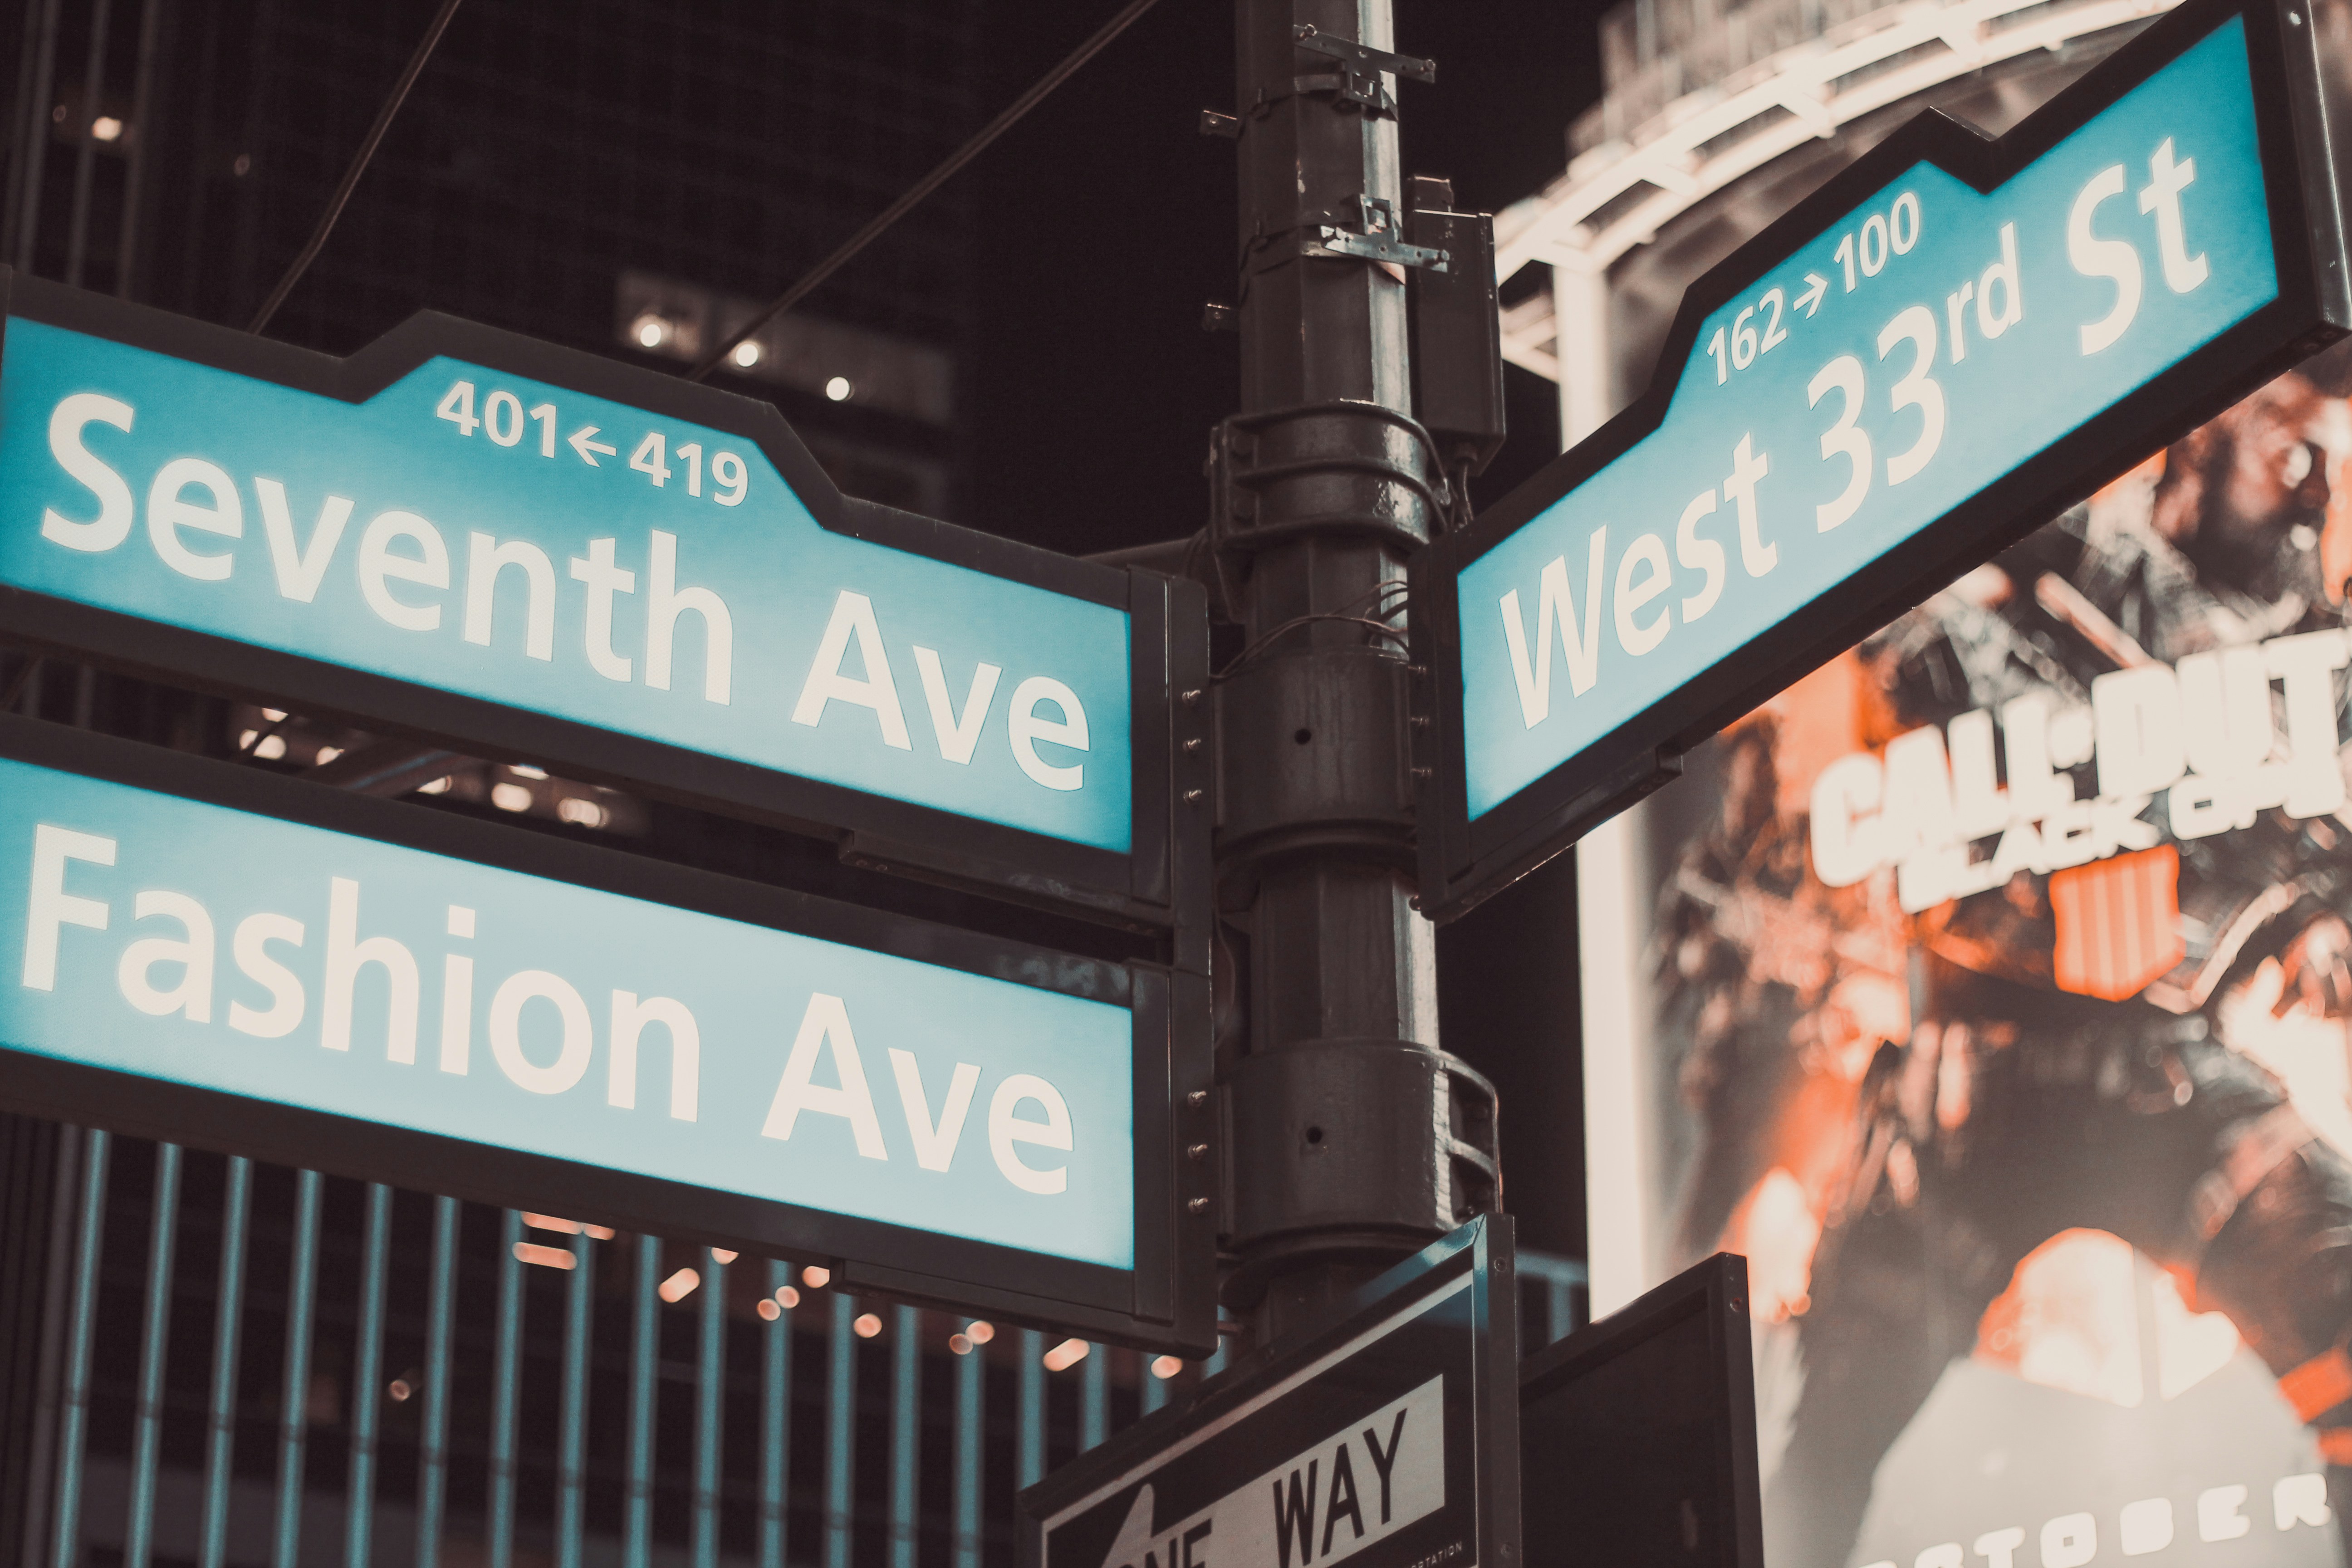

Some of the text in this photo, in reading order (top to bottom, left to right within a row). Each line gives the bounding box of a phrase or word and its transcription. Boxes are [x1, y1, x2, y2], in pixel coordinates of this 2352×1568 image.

[1706, 191, 1920, 387] 162 100
[436, 380, 749, 507] 401 419
[1498, 136, 2210, 731] West 33rd St
[41, 392, 1091, 792] Seventh Ave
[22, 823, 1074, 1195] Fashion Ave
[1272, 1407, 1408, 1568] WAY
